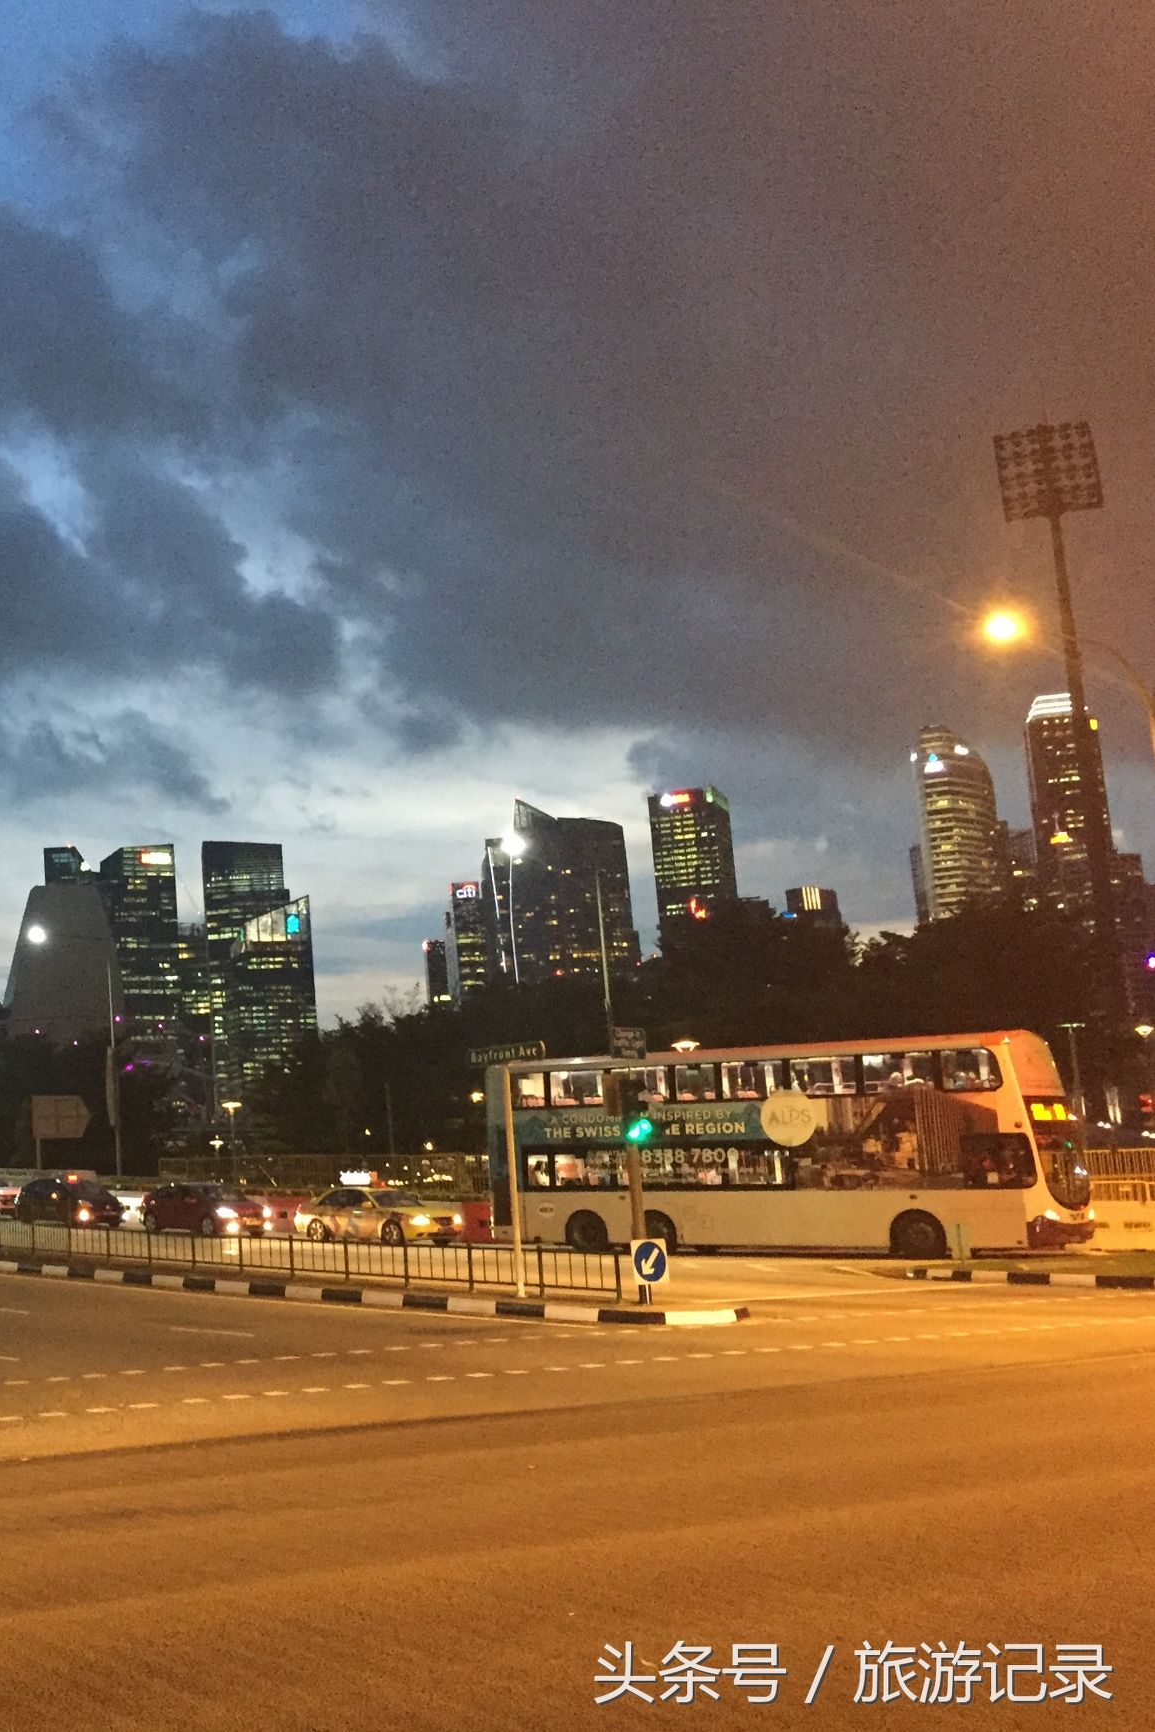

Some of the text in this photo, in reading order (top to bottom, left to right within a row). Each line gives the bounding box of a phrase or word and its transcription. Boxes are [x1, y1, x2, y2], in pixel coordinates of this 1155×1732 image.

[456, 885, 477, 898] citi
[470, 1045, 538, 1064] Bayfront Ave
[653, 1109, 712, 1121] INSPIRED
[716, 1108, 732, 1119] BY
[768, 1108, 812, 1125] ALPS
[544, 1127, 572, 1139] THE
[575, 1125, 621, 1138] SWISS
[685, 1121, 746, 1135] REGION
